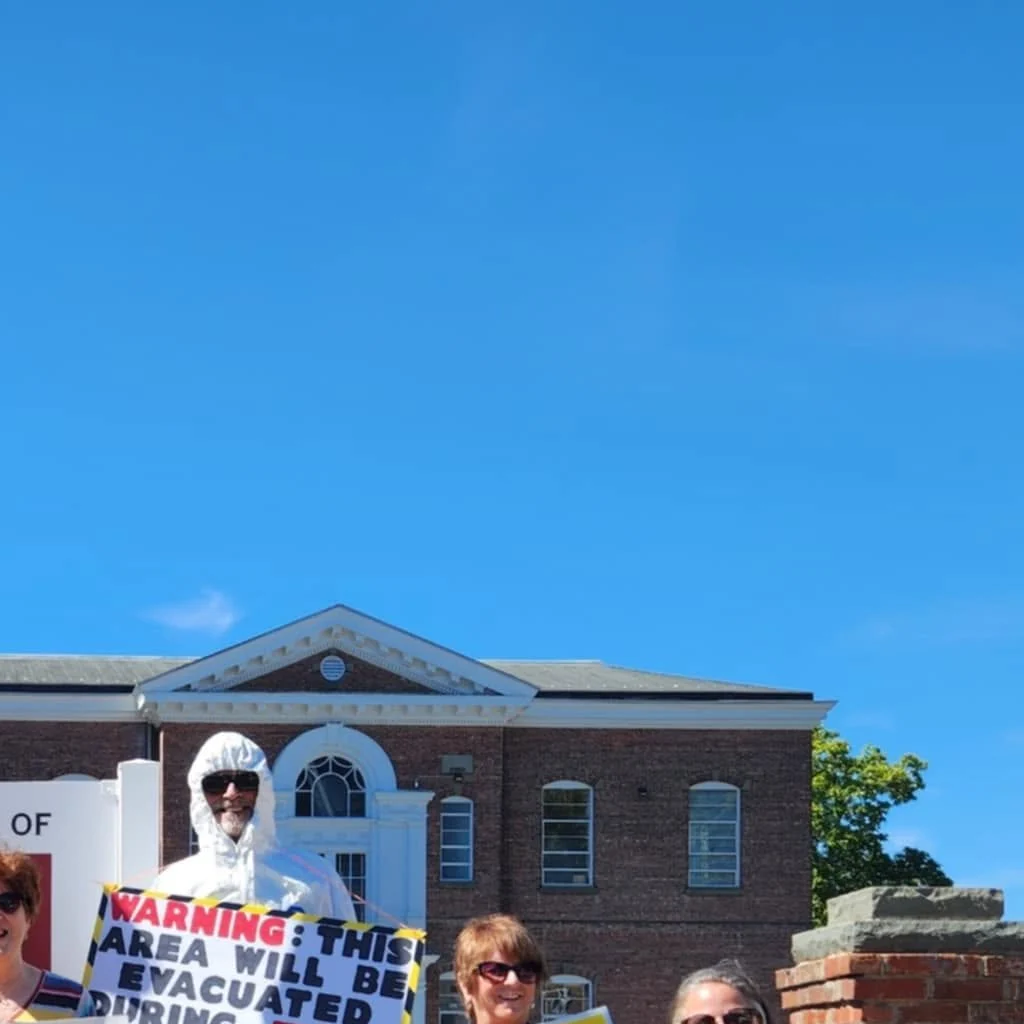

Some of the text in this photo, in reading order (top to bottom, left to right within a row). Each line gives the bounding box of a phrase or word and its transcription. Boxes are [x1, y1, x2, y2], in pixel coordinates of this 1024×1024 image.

[11, 813, 52, 836] OF
[99, 926, 409, 1000] AREA WILL BE
[317, 923, 414, 966] THIS
